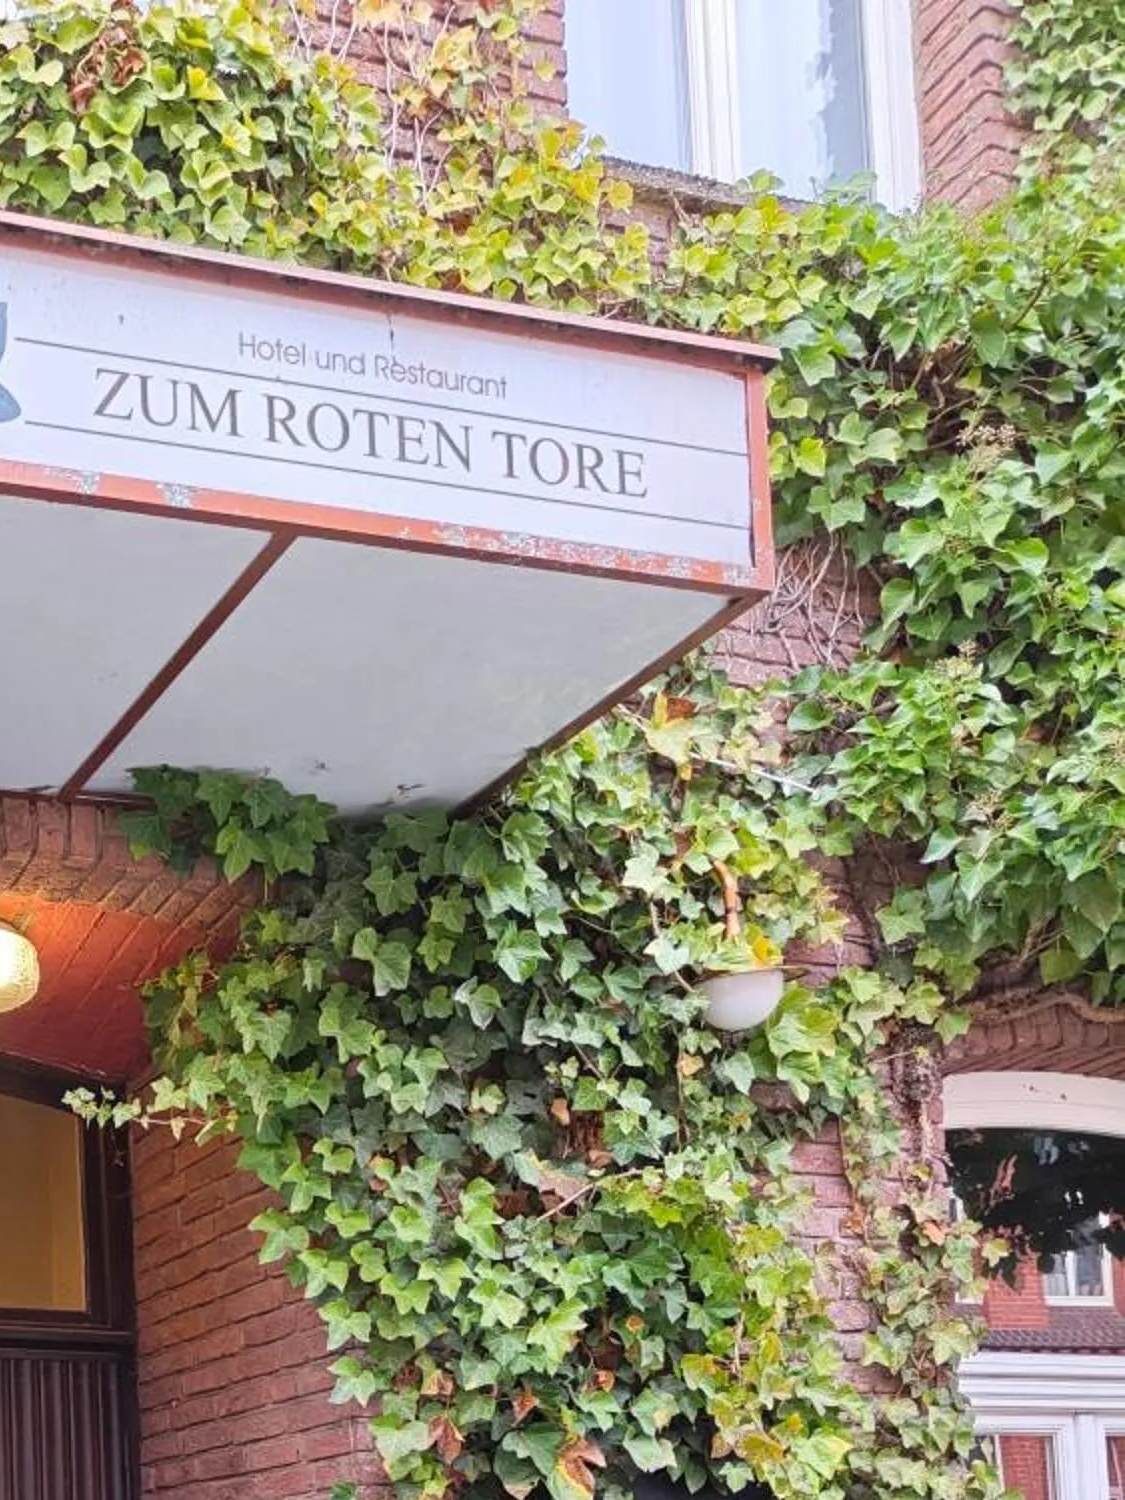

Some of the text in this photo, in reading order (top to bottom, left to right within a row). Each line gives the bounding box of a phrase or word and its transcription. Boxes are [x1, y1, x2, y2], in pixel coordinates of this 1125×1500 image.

[237, 331, 508, 399] Hotel und Restaurant
[93, 367, 648, 498] ZUM ROTEN TORE
